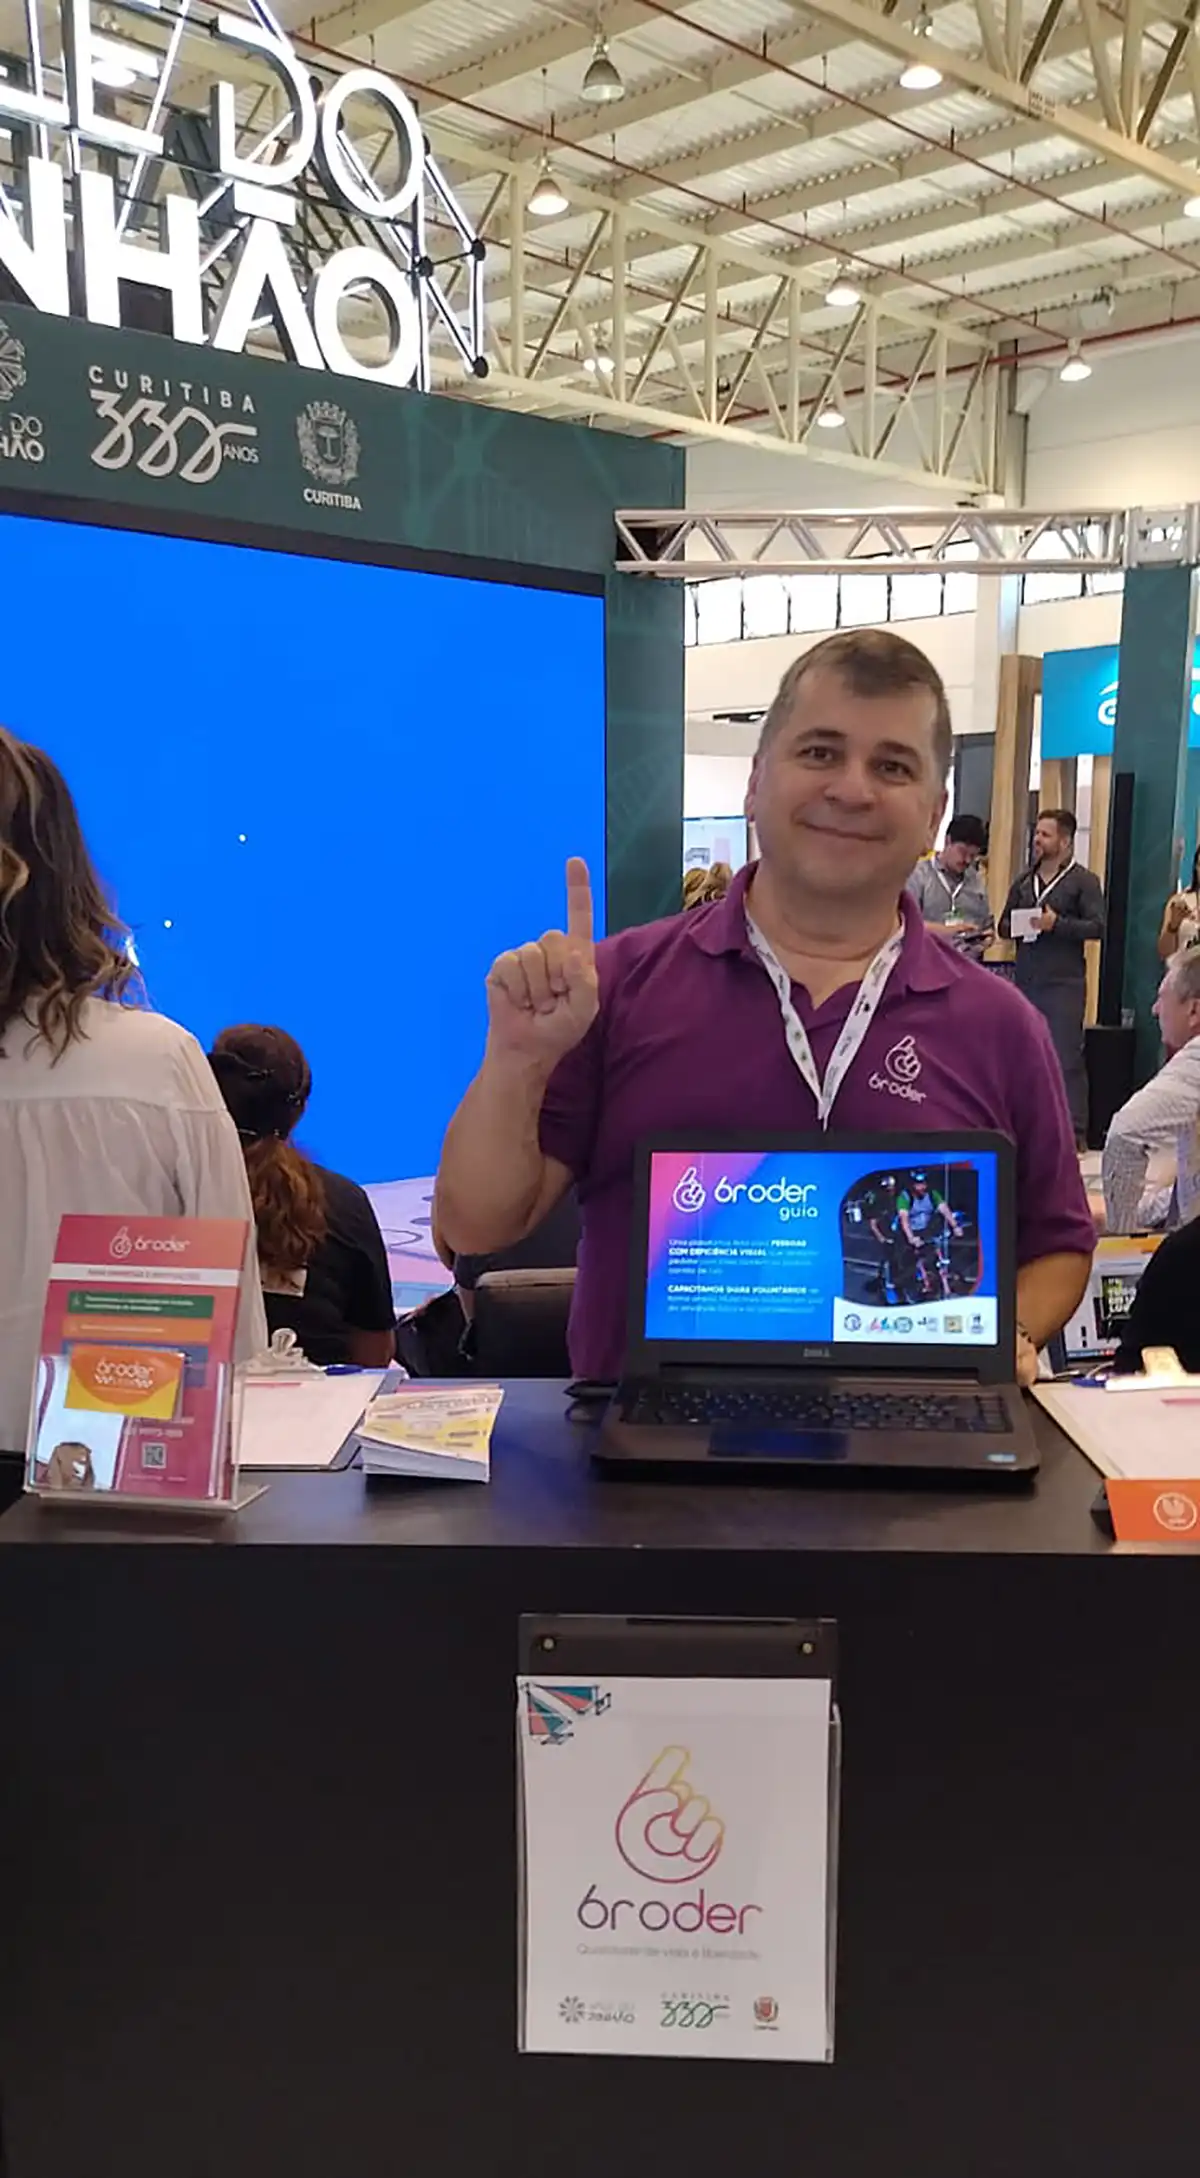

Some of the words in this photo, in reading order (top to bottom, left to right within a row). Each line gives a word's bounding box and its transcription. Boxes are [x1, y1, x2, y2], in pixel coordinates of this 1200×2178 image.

[209, 14, 424, 218] DO
[89, 365, 257, 414] CURITIBA
[9, 412, 43, 437] DO
[222, 444, 260, 465] ANOS
[303, 487, 363, 511] CURITIBA
[779, 1202, 818, 1222] guia
